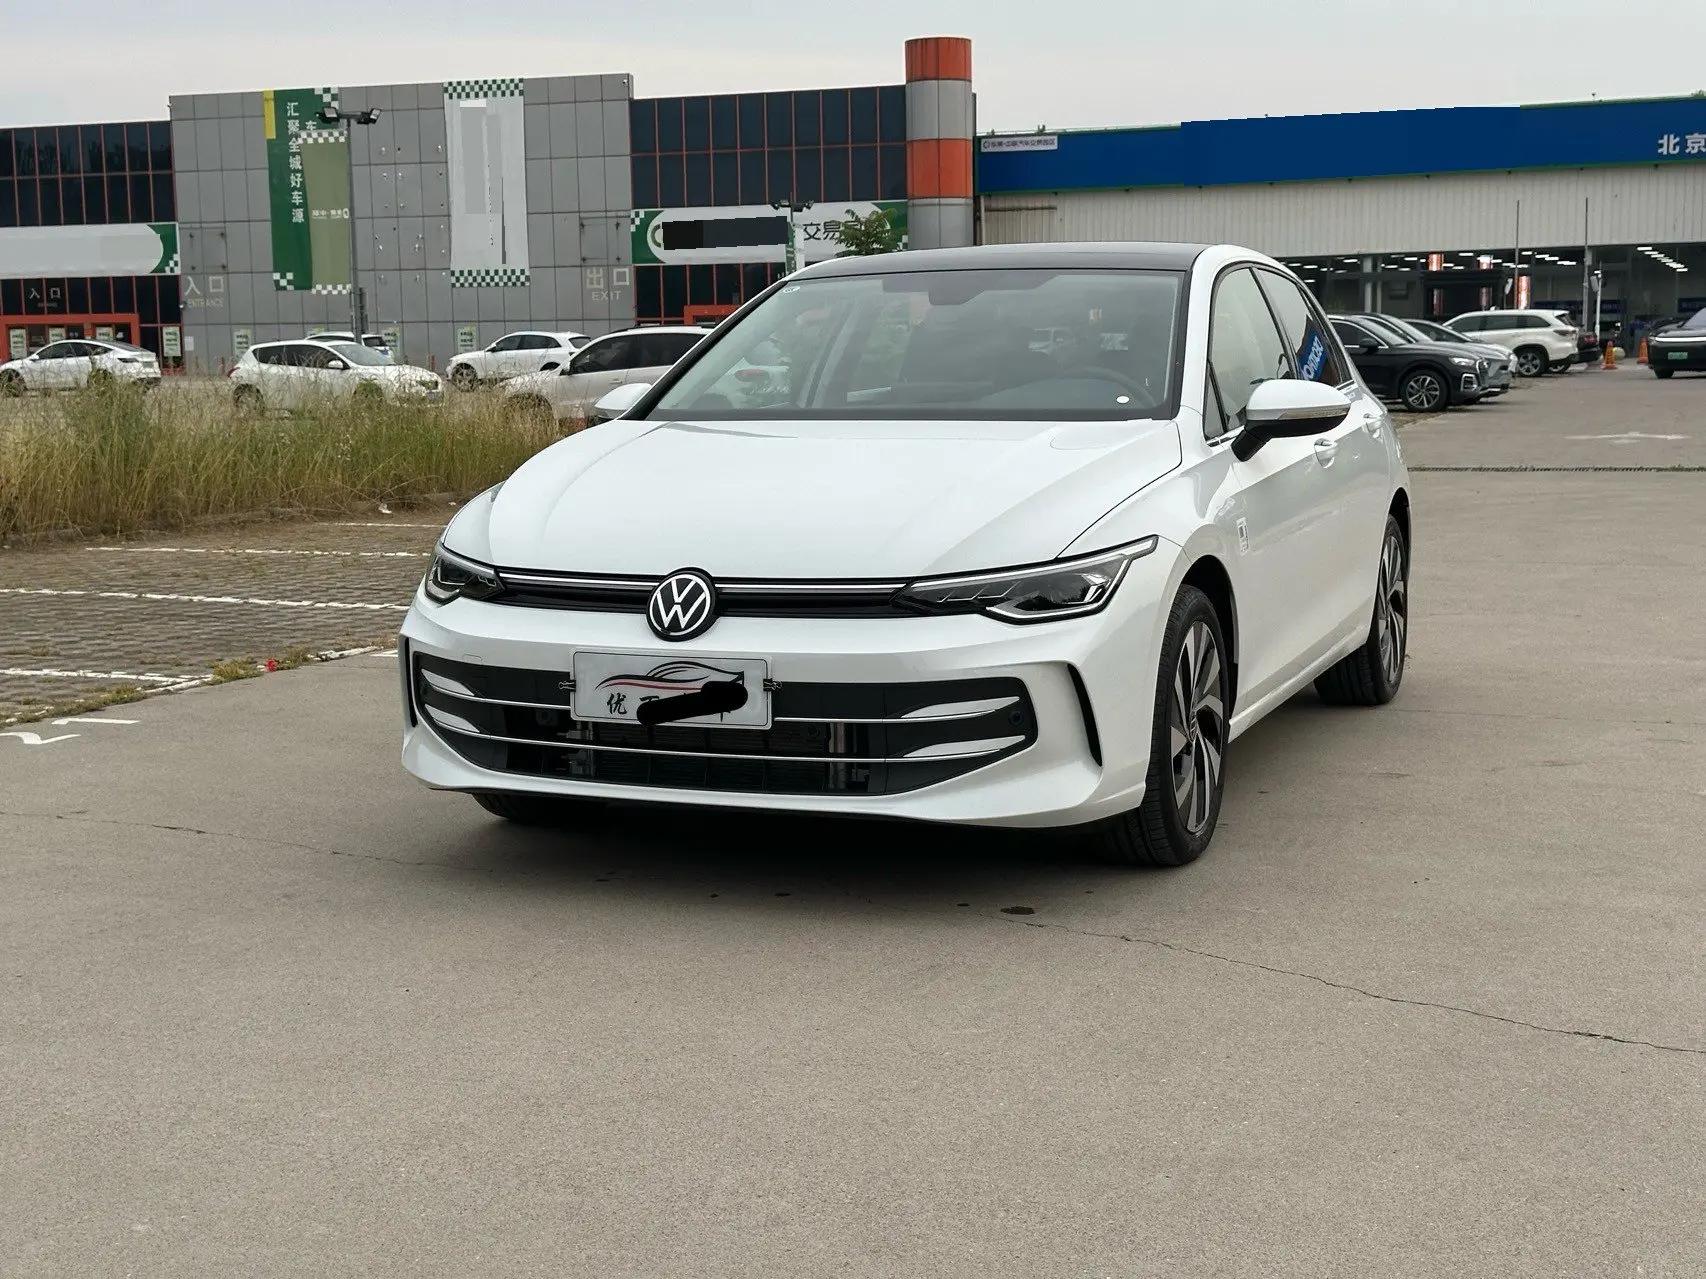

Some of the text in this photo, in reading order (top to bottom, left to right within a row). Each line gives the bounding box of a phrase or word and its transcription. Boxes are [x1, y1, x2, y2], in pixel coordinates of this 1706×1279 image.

[1657, 133, 1706, 155] 北京
[286, 102, 305, 223] 汇聚全城好车源
[184, 276, 224, 297] 入口
[586, 266, 630, 289] 出口
[29, 287, 61, 299] 入口
[591, 290, 622, 301] EXIT
